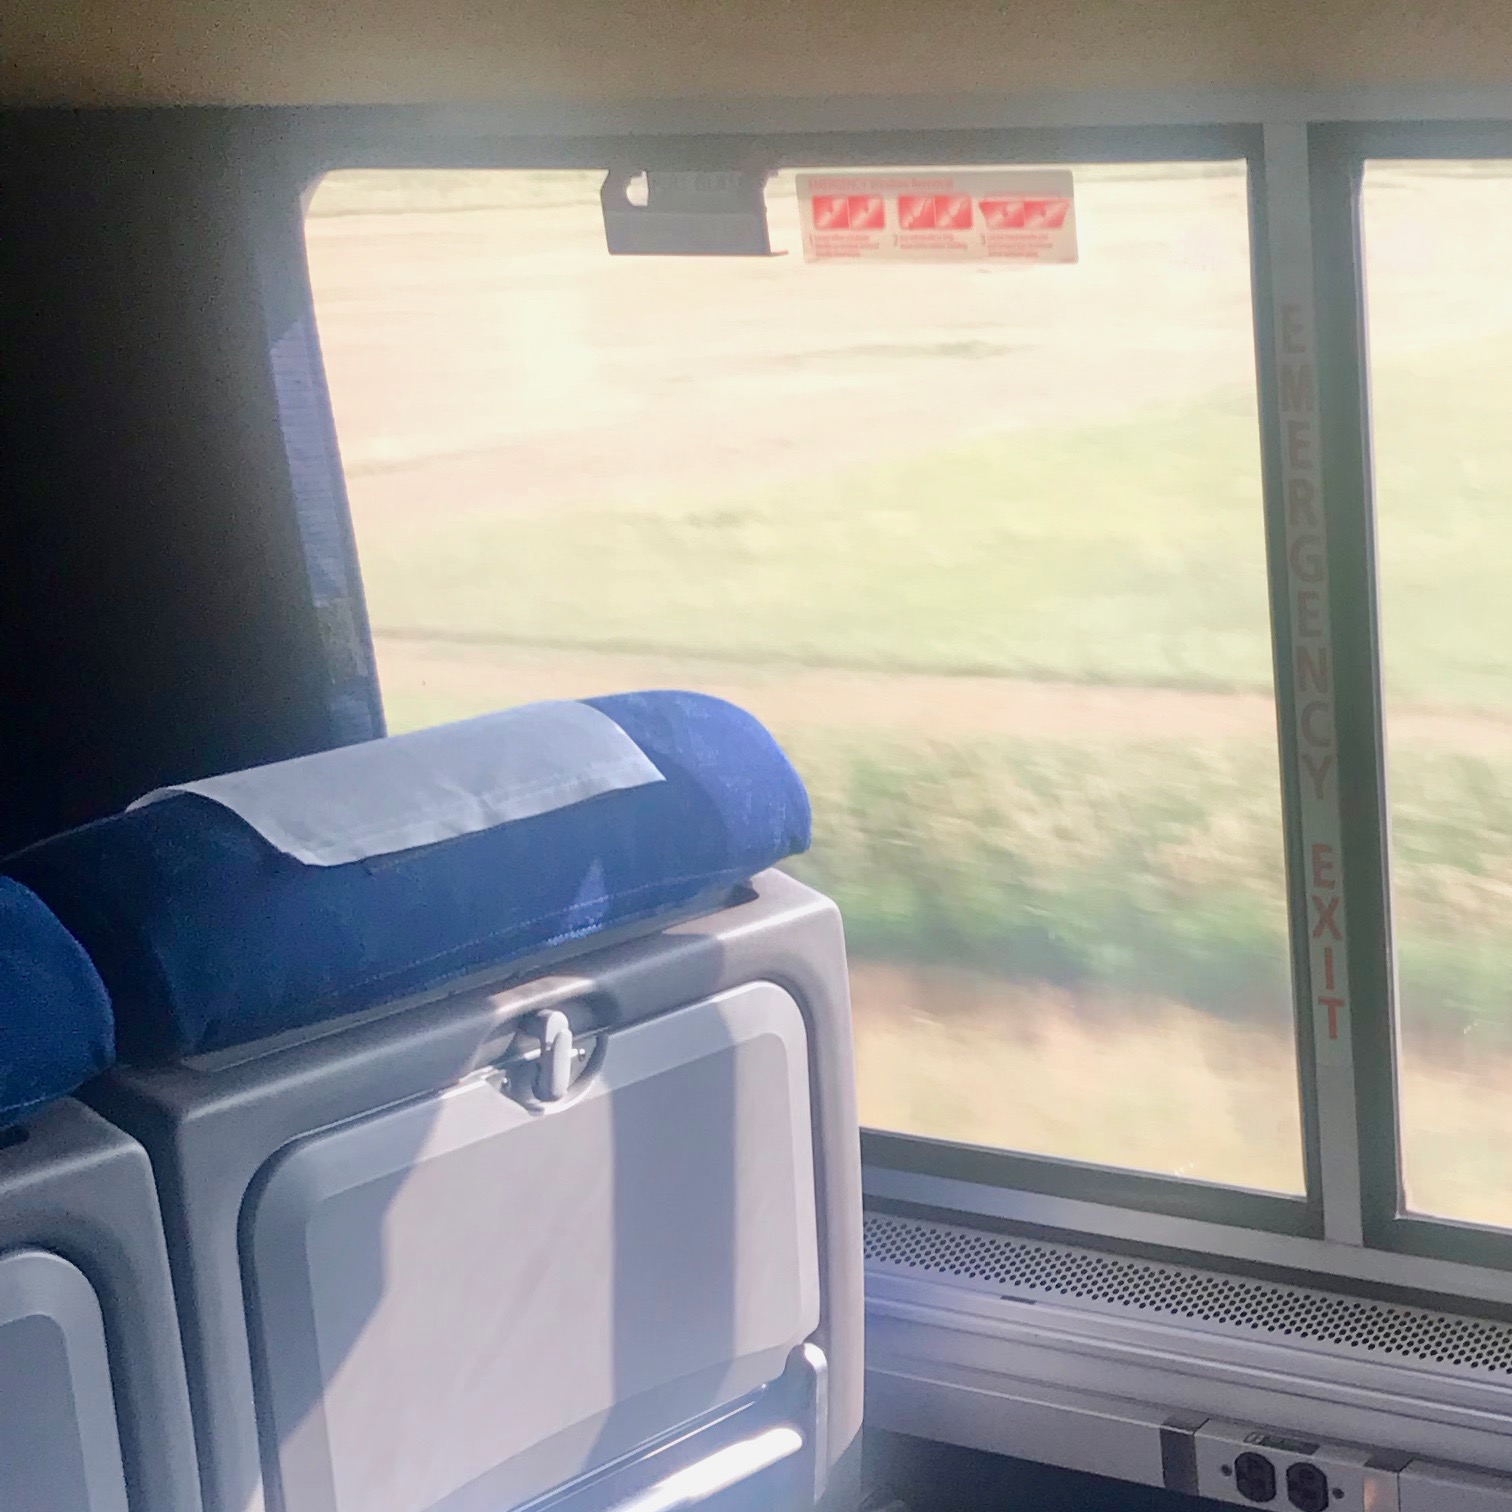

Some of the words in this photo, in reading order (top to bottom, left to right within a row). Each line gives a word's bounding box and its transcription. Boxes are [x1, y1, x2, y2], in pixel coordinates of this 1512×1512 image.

[870, 178, 910, 190] Window
[1280, 303, 1338, 800] EMERGENCY
[1311, 843, 1345, 1040] EXIT
